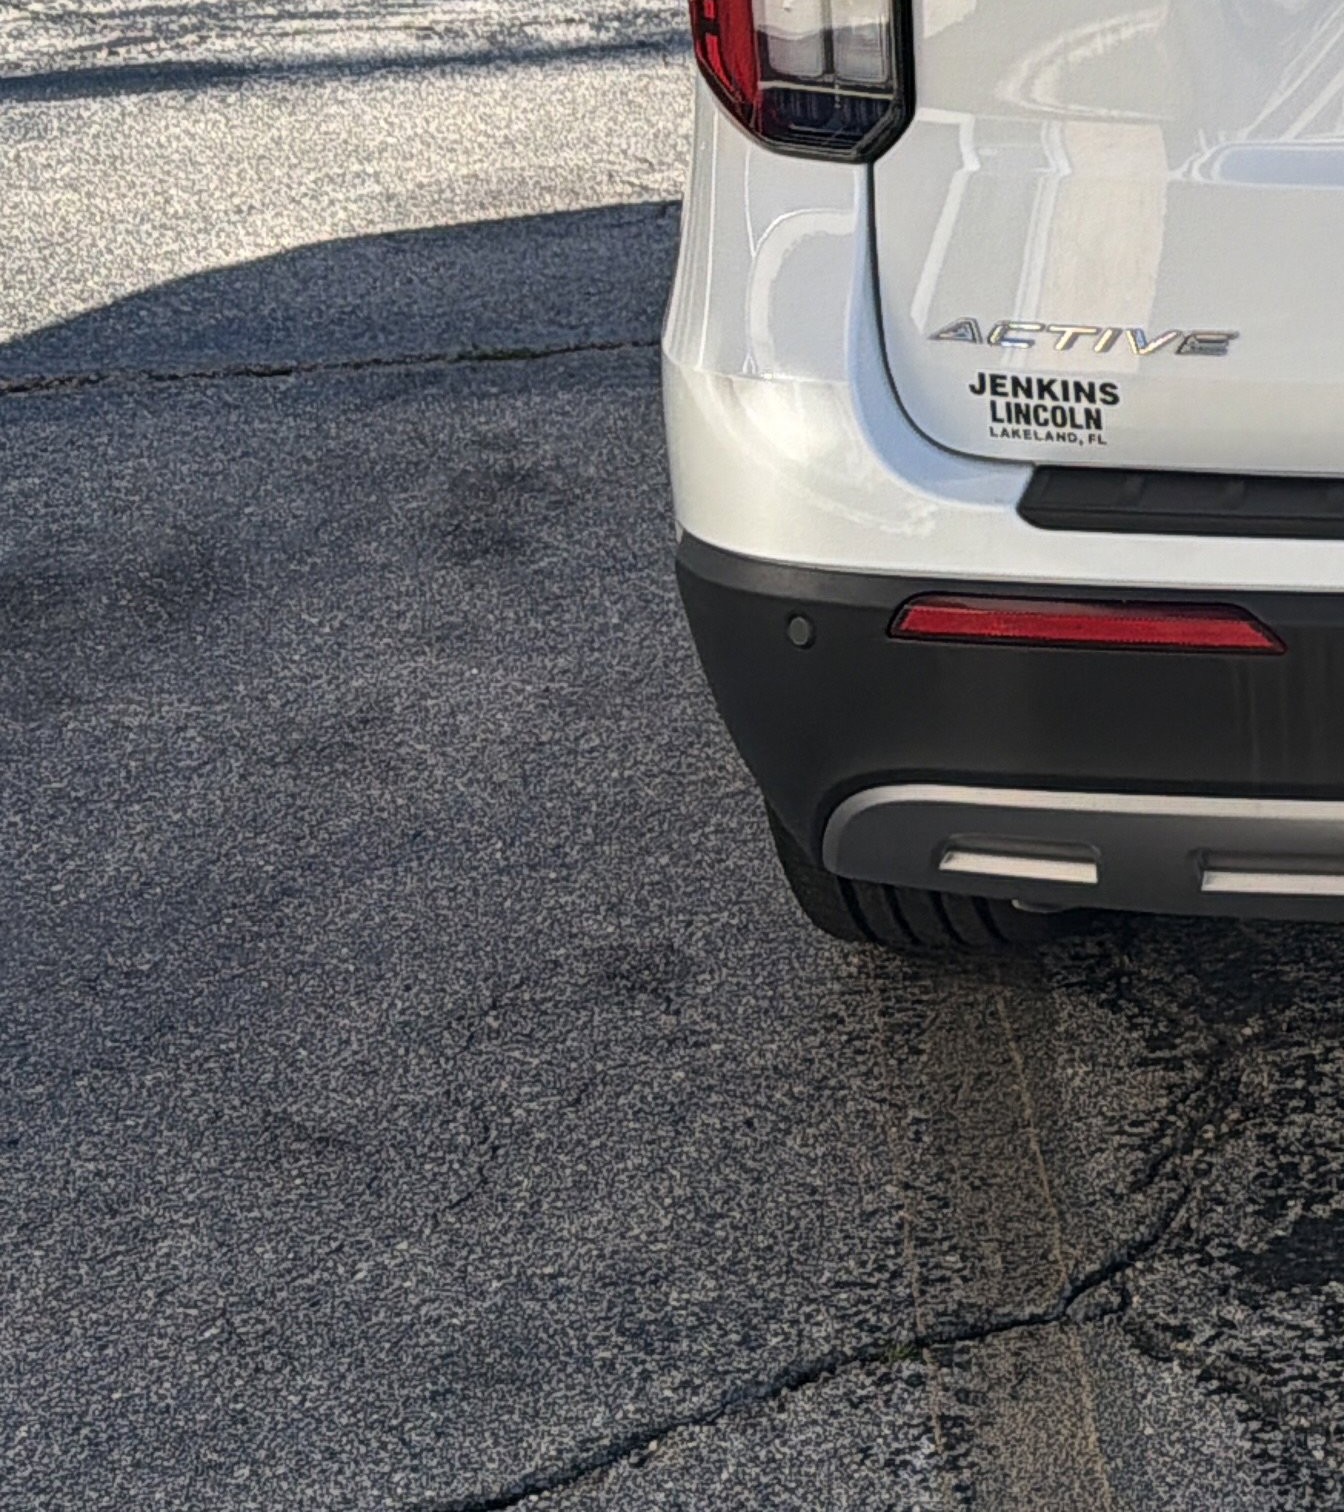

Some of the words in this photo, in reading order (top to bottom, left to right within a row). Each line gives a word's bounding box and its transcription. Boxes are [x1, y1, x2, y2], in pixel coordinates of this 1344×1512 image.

[928, 316, 1240, 356] ACTIVE
[968, 372, 1120, 406] JENKINS
[990, 400, 1103, 430] LINCOLN
[989, 426, 1084, 446] LAKELAND,
[1088, 433, 1108, 445] FL
